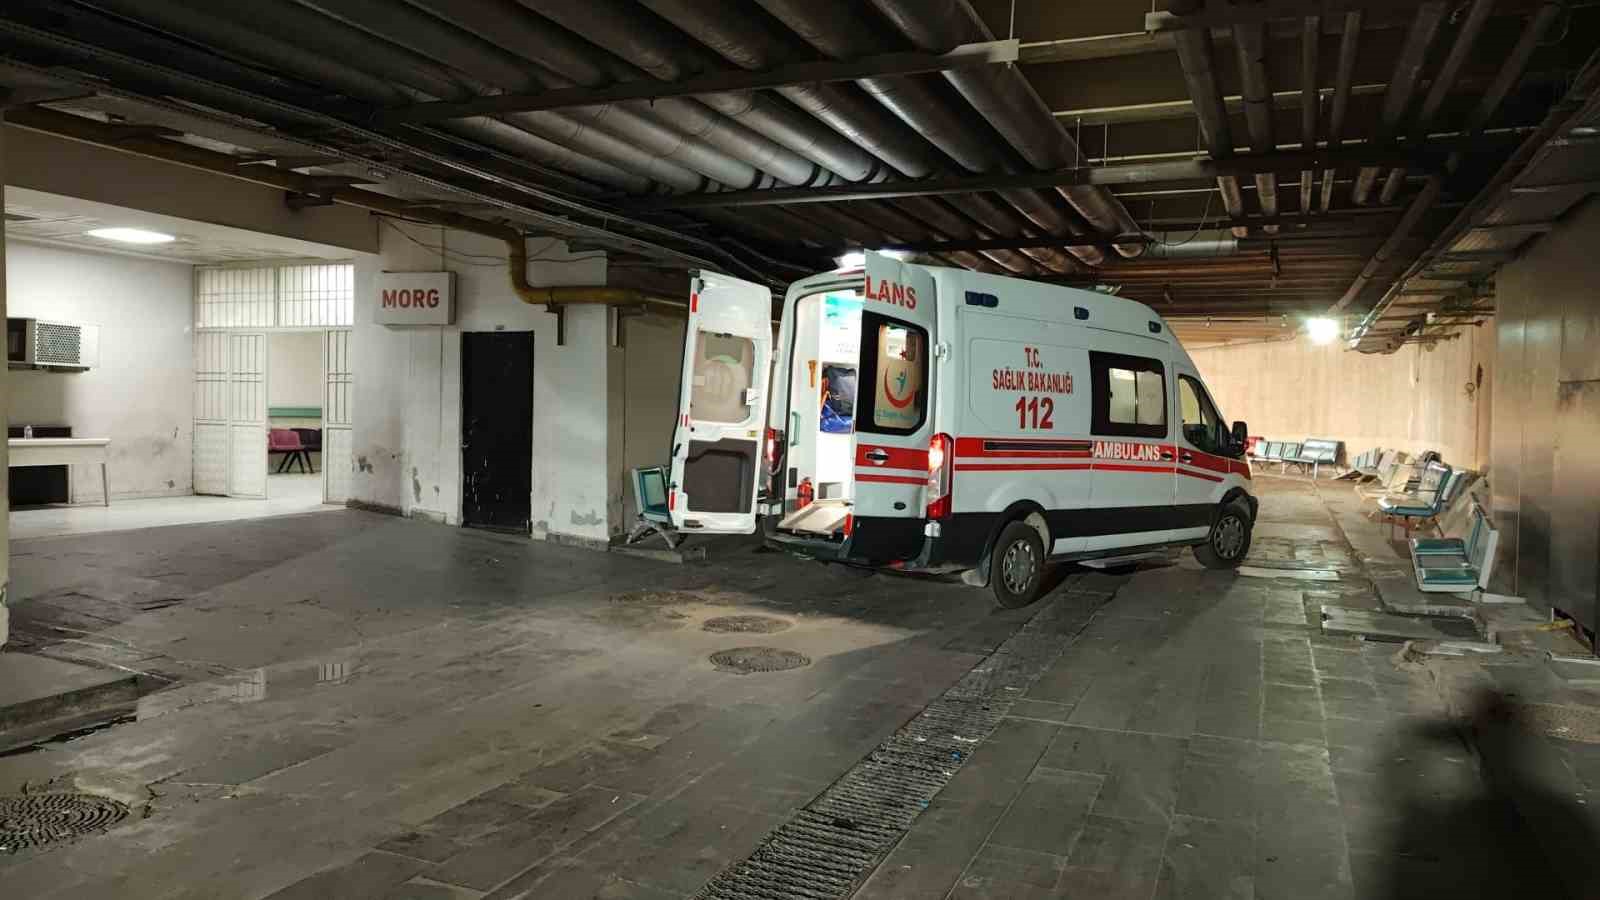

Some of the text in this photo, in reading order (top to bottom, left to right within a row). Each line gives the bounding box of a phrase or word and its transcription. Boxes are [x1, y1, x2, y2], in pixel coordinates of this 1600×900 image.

[382, 288, 440, 309] MORG
[865, 276, 917, 310] LANS
[1024, 347, 1044, 369] T.C.
[992, 366, 1074, 395] SAĞLIK BAKANLIĞI
[1015, 396, 1054, 430] 112
[1094, 440, 1161, 461] AMBULANS
